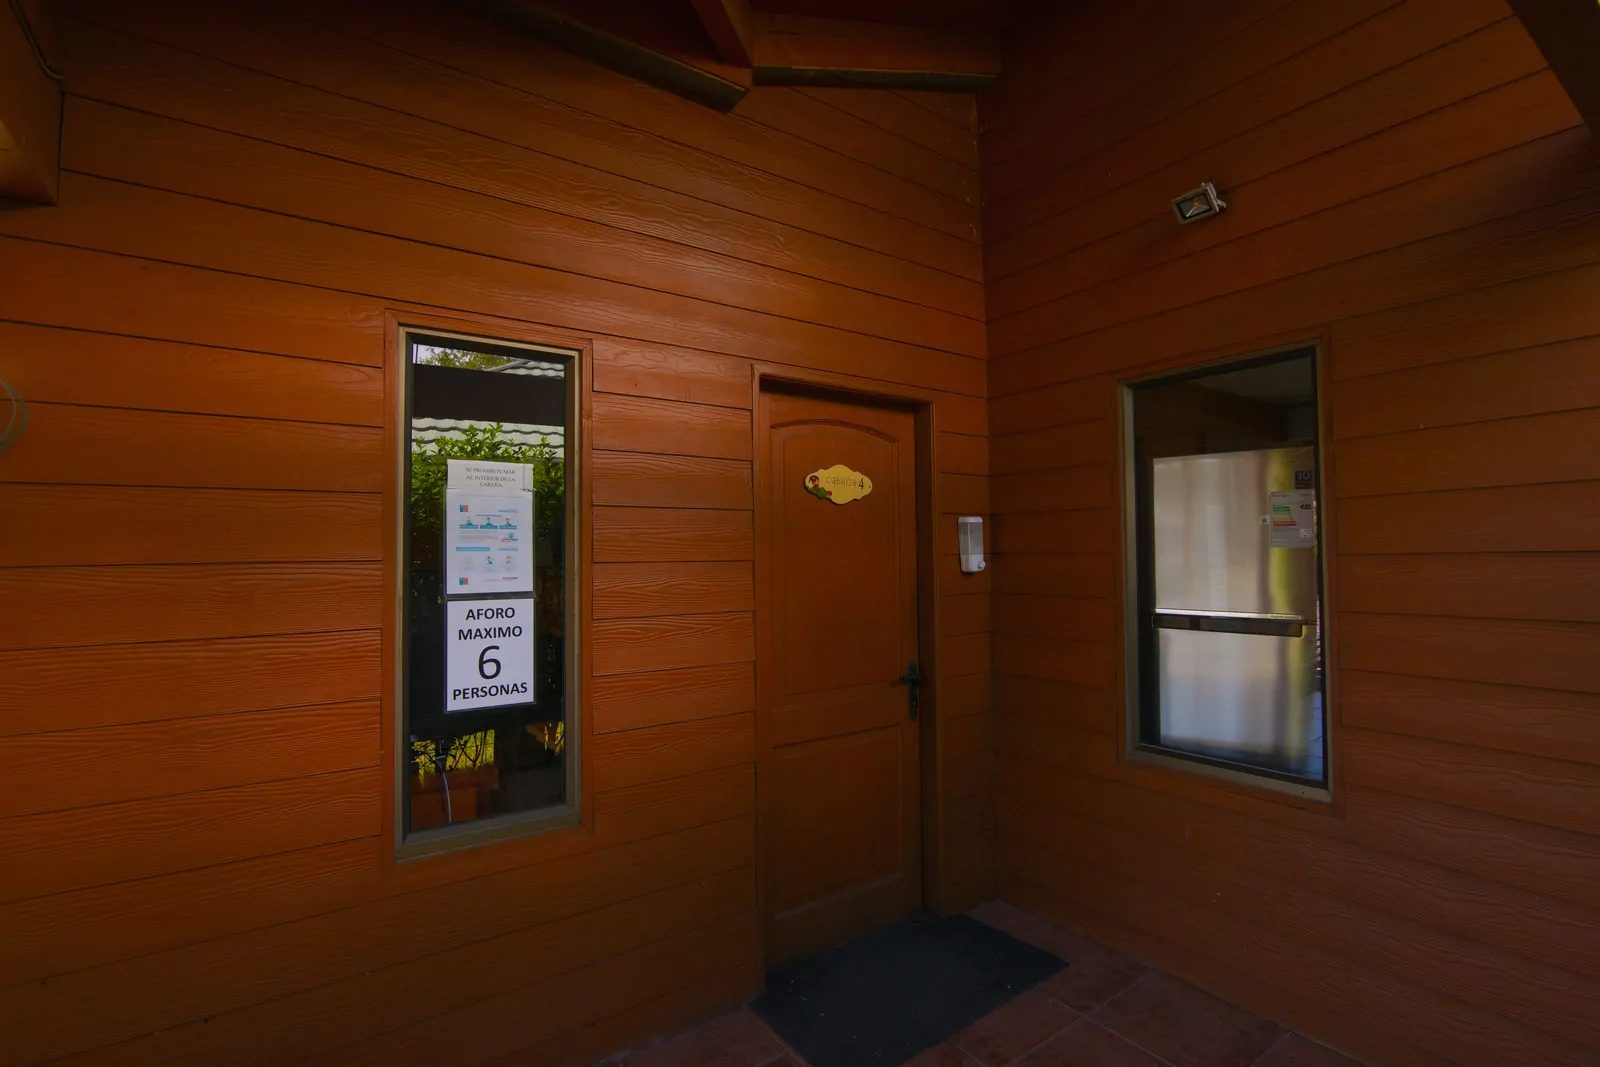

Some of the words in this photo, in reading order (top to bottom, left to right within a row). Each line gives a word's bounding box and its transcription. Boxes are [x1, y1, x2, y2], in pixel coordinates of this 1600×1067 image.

[858, 478, 865, 490] 4
[465, 607, 516, 621] AFORO
[458, 625, 523, 641] MAXIMO
[478, 645, 501, 680] 6
[453, 682, 528, 701] PERSONAS
